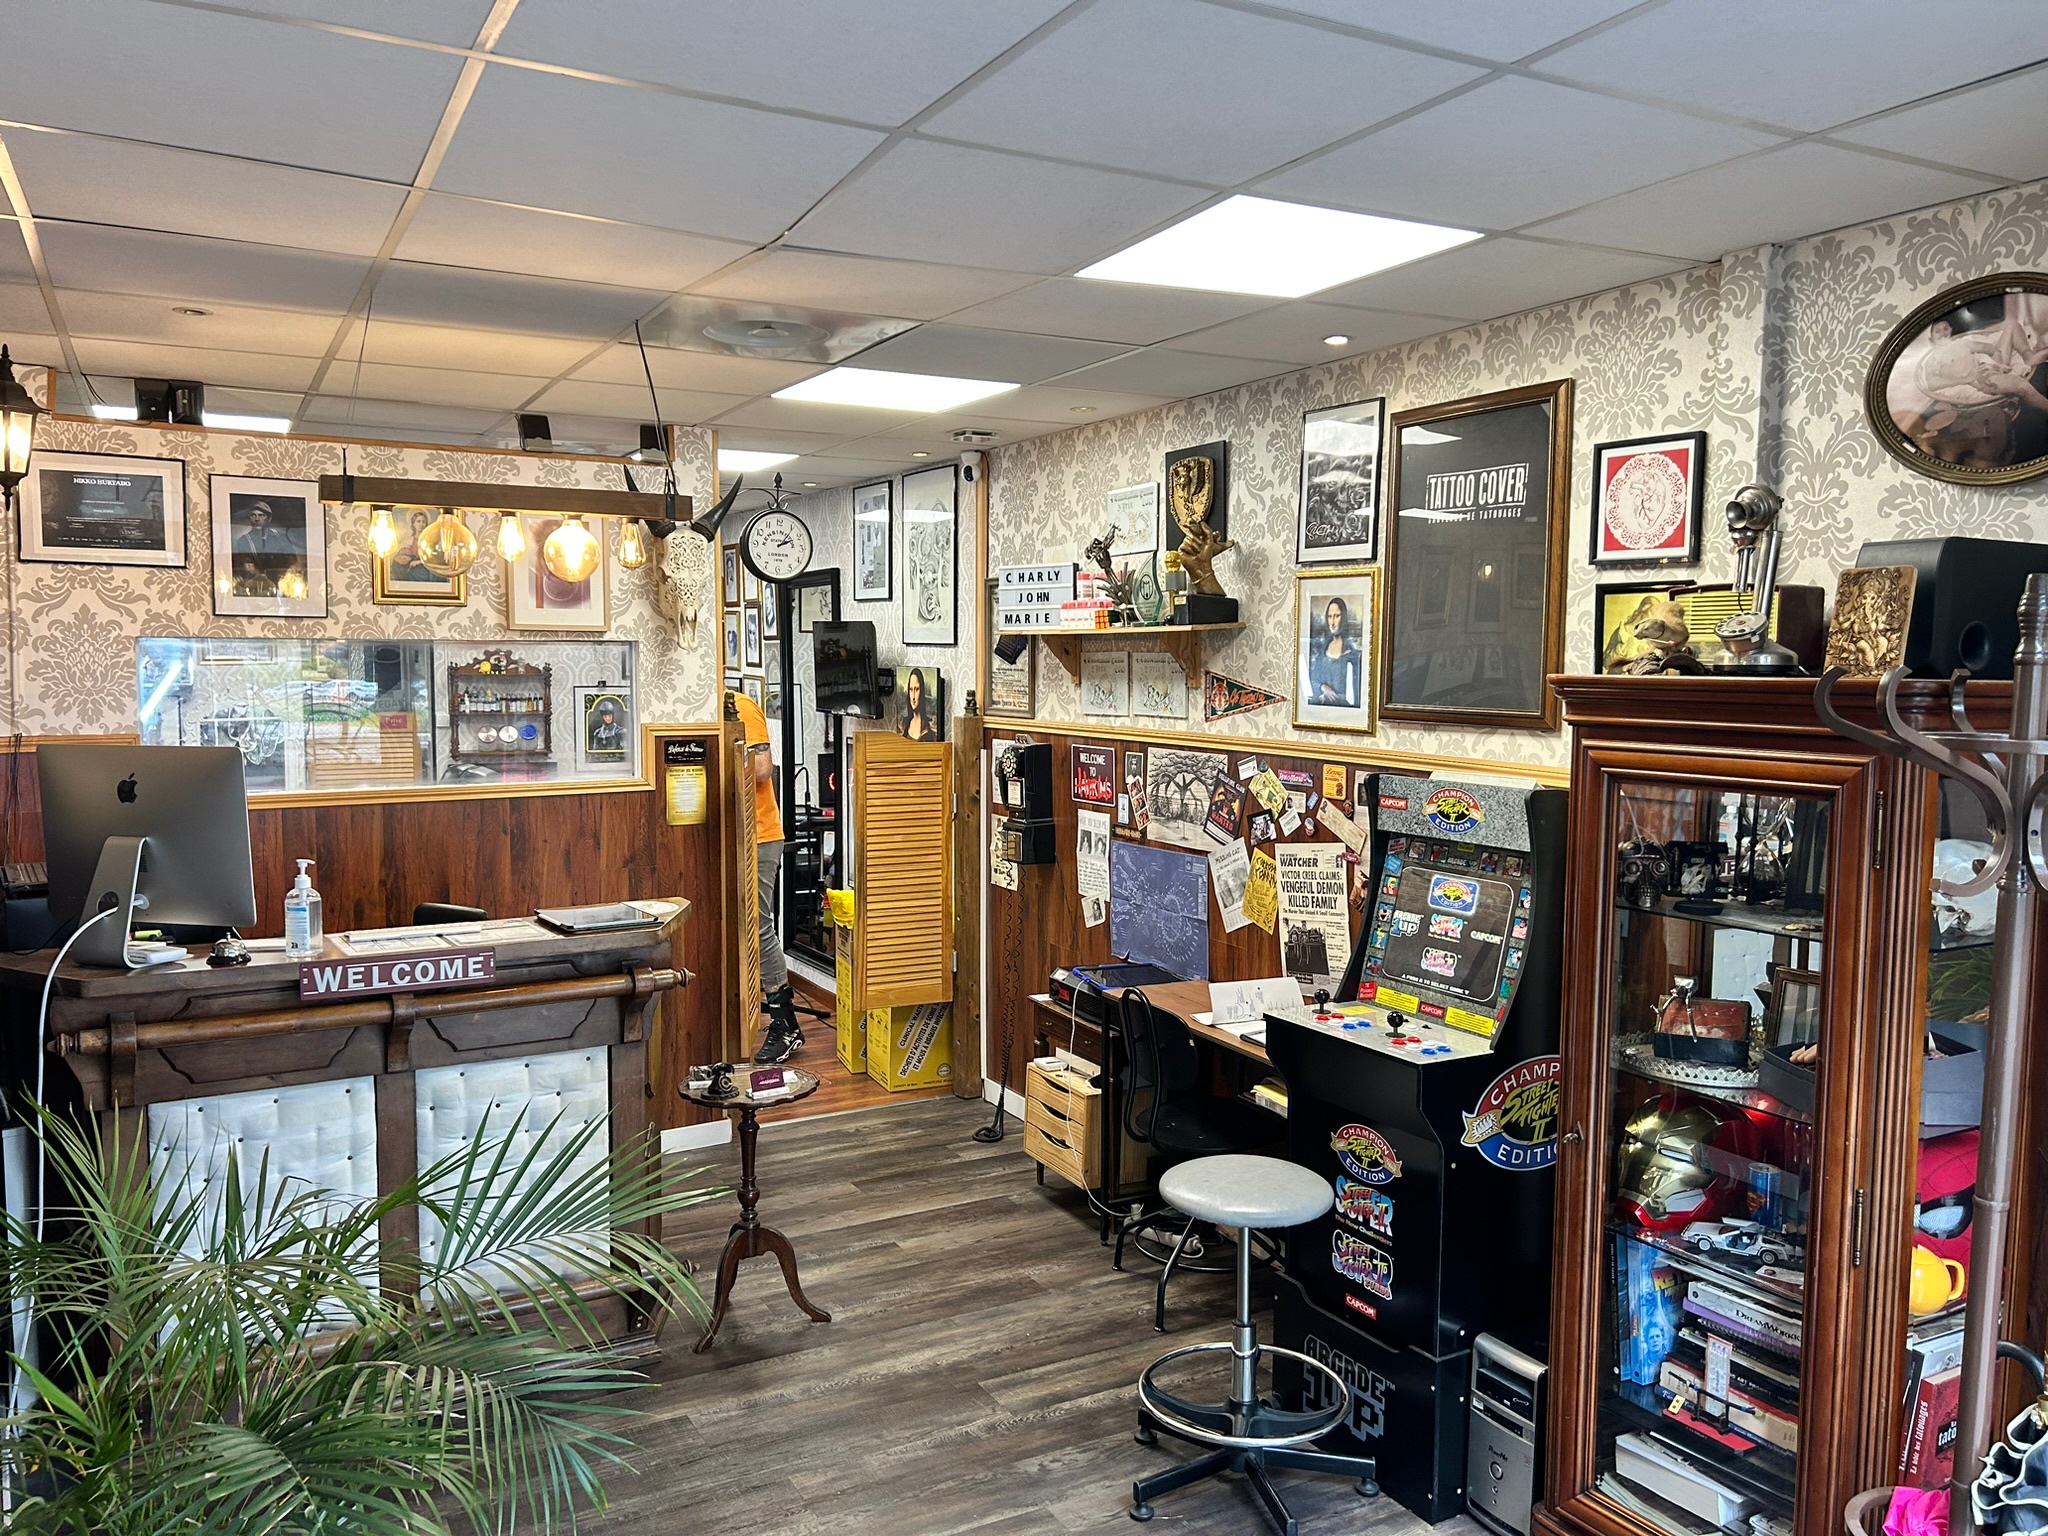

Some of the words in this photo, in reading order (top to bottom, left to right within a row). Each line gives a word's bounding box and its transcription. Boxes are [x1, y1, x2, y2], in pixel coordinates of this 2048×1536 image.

[97, 479, 131, 487] HURTADO
[1429, 474, 1475, 509] TATTOO
[1478, 467, 1525, 505] COVER
[1479, 508, 1522, 519] TATOUAGES
[765, 521, 771, 529] 11
[753, 540, 759, 548] 9
[796, 533, 802, 541] 2
[756, 552, 761, 560] 8
[764, 561, 769, 569] 7
[775, 566, 780, 575] 6
[1006, 570, 1060, 583] CHARLY
[1019, 592, 1049, 603] JOHN
[1004, 613, 1050, 624] MARIE
[1079, 752, 1106, 766] WELCOME
[1089, 767, 1096, 777] TO
[1380, 798, 1406, 808] CAPCOM
[1432, 790, 1475, 807] CHAMPION
[1211, 811, 1234, 831] WANTED
[1435, 817, 1471, 832] EDITION
[1280, 857, 1318, 868] WATCHER
[1280, 870, 1301, 880] VICTOR
[1302, 871, 1317, 880] CREEL
[1319, 871, 1343, 881] CLAIMS:
[1280, 881, 1315, 894] VENGEFUL
[1316, 882, 1344, 895] DEMON
[1288, 895, 1310, 908] KILLED
[1311, 895, 1338, 909] FAMILY
[1470, 931, 1502, 945] CAPCOM
[312, 956, 485, 993] WELCOME
[1420, 1004, 1444, 1017] CAPCOM
[899, 1021, 915, 1047] CLINICAL
[899, 1055, 915, 1077] DECHETS
[1500, 1078, 1554, 1127] STREET
[1528, 1117, 1553, 1146] II
[1342, 1127, 1390, 1155] CHAMPION
[1352, 1146, 1384, 1164] FIGHTER
[1345, 1158, 1386, 1181] EDITION
[1361, 1156, 1371, 1169] II
[1340, 1182, 1372, 1200] STREET
[1335, 1213, 1345, 1223] The
[1345, 1218, 1359, 1231] New
[1358, 1225, 1393, 1247] Challengers
[1338, 1239, 1371, 1257] STREET
[1346, 1296, 1375, 1317] CAPCOM
[1304, 1334, 1386, 1411] ARCADE
[1914, 1399, 1929, 1442] tatouages
